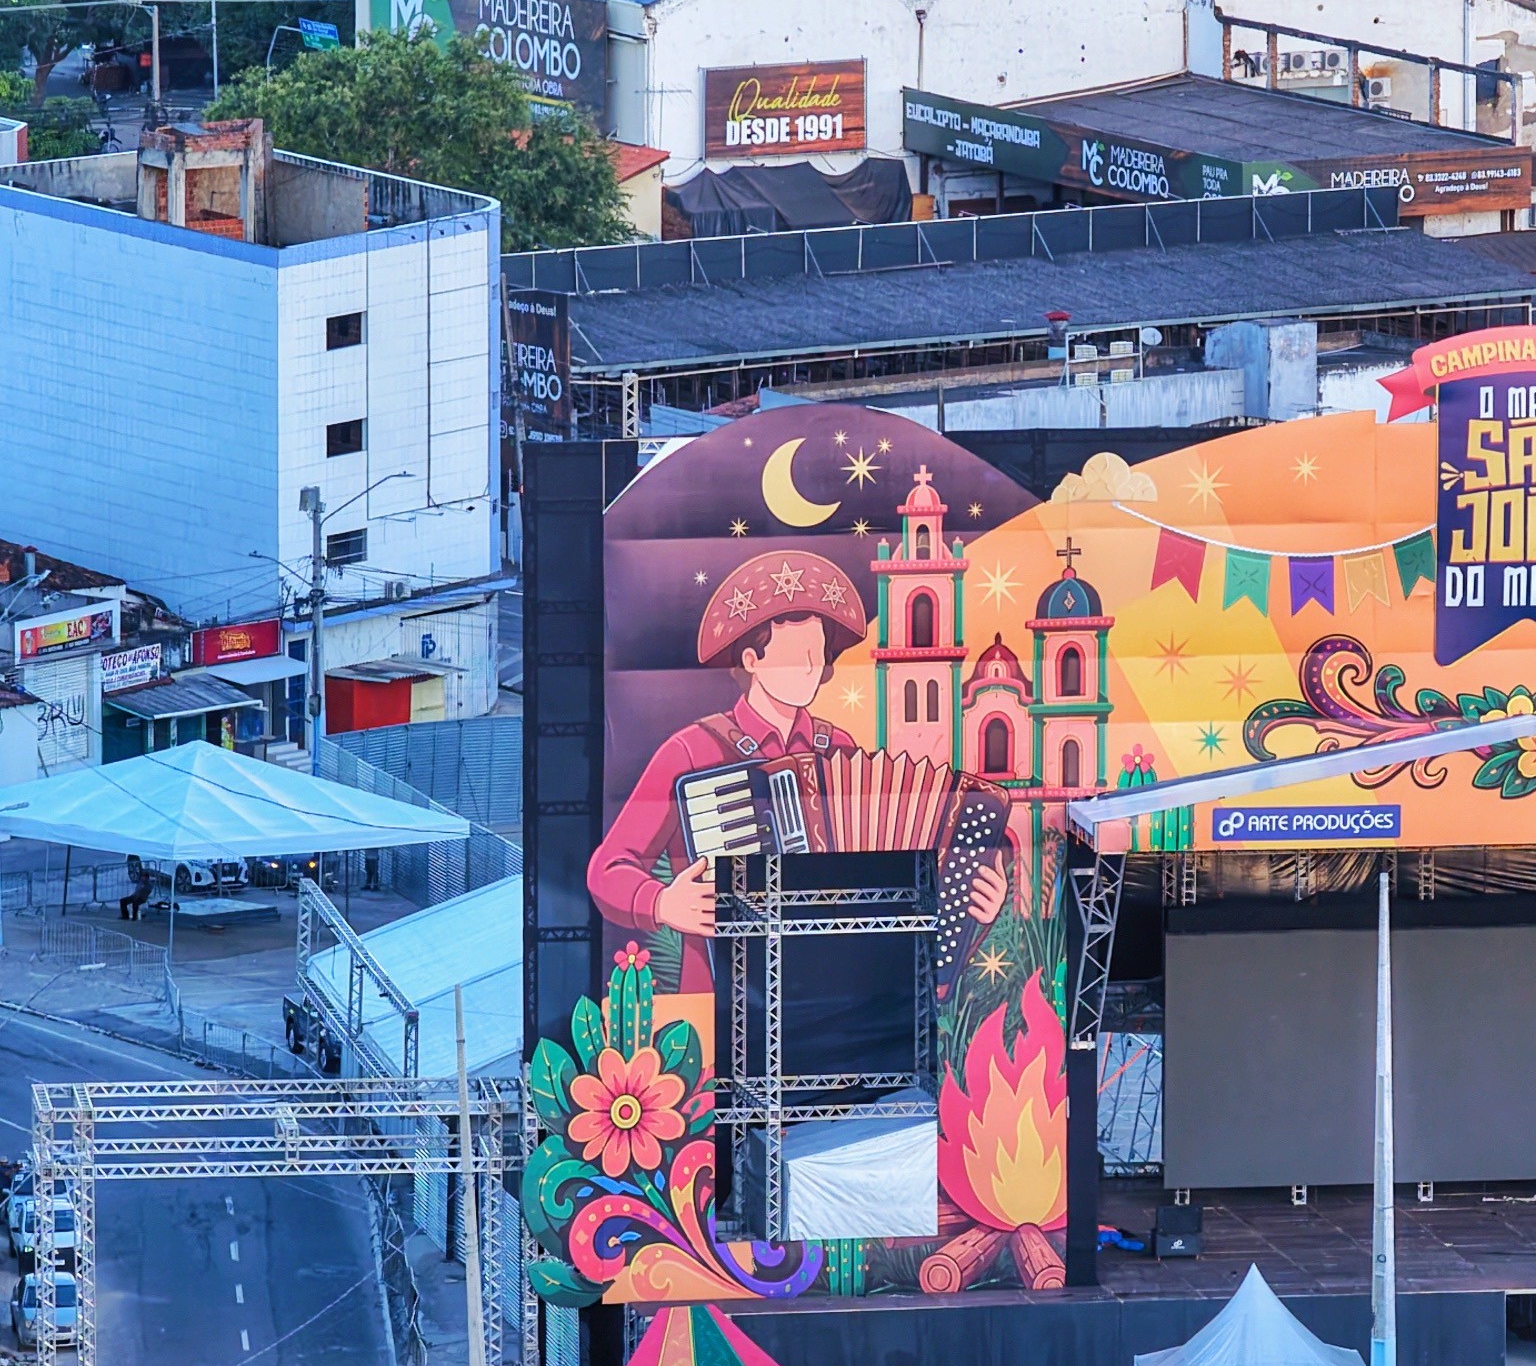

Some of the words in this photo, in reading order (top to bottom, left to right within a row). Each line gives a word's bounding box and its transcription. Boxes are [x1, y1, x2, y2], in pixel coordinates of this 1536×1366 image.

[475, 23, 582, 81] COLOMBO
[542, 81, 564, 98] OBRA
[728, 74, 842, 123] Qualidade
[725, 116, 791, 146] DESDE
[795, 113, 843, 142] 1991
[905, 101, 961, 132] EUCALIPTO
[970, 116, 1040, 149] MAÇARANDUBA
[955, 138, 994, 165] JATOBÁ
[1110, 144, 1165, 176] MADEIREIRA
[1107, 164, 1169, 199] COLOMBO
[1331, 168, 1411, 189] MADEIREIRA
[1434, 183, 1465, 194] Agradeço
[1470, 182, 1488, 192] Deus!
[536, 303, 557, 317] Deus!
[1479, 385, 1494, 419] O
[1445, 564, 1485, 608] DO
[102, 652, 127, 671] OTECO
[1248, 814, 1289, 832] ARTE
[1292, 810, 1394, 834] PRODUÇÕES
